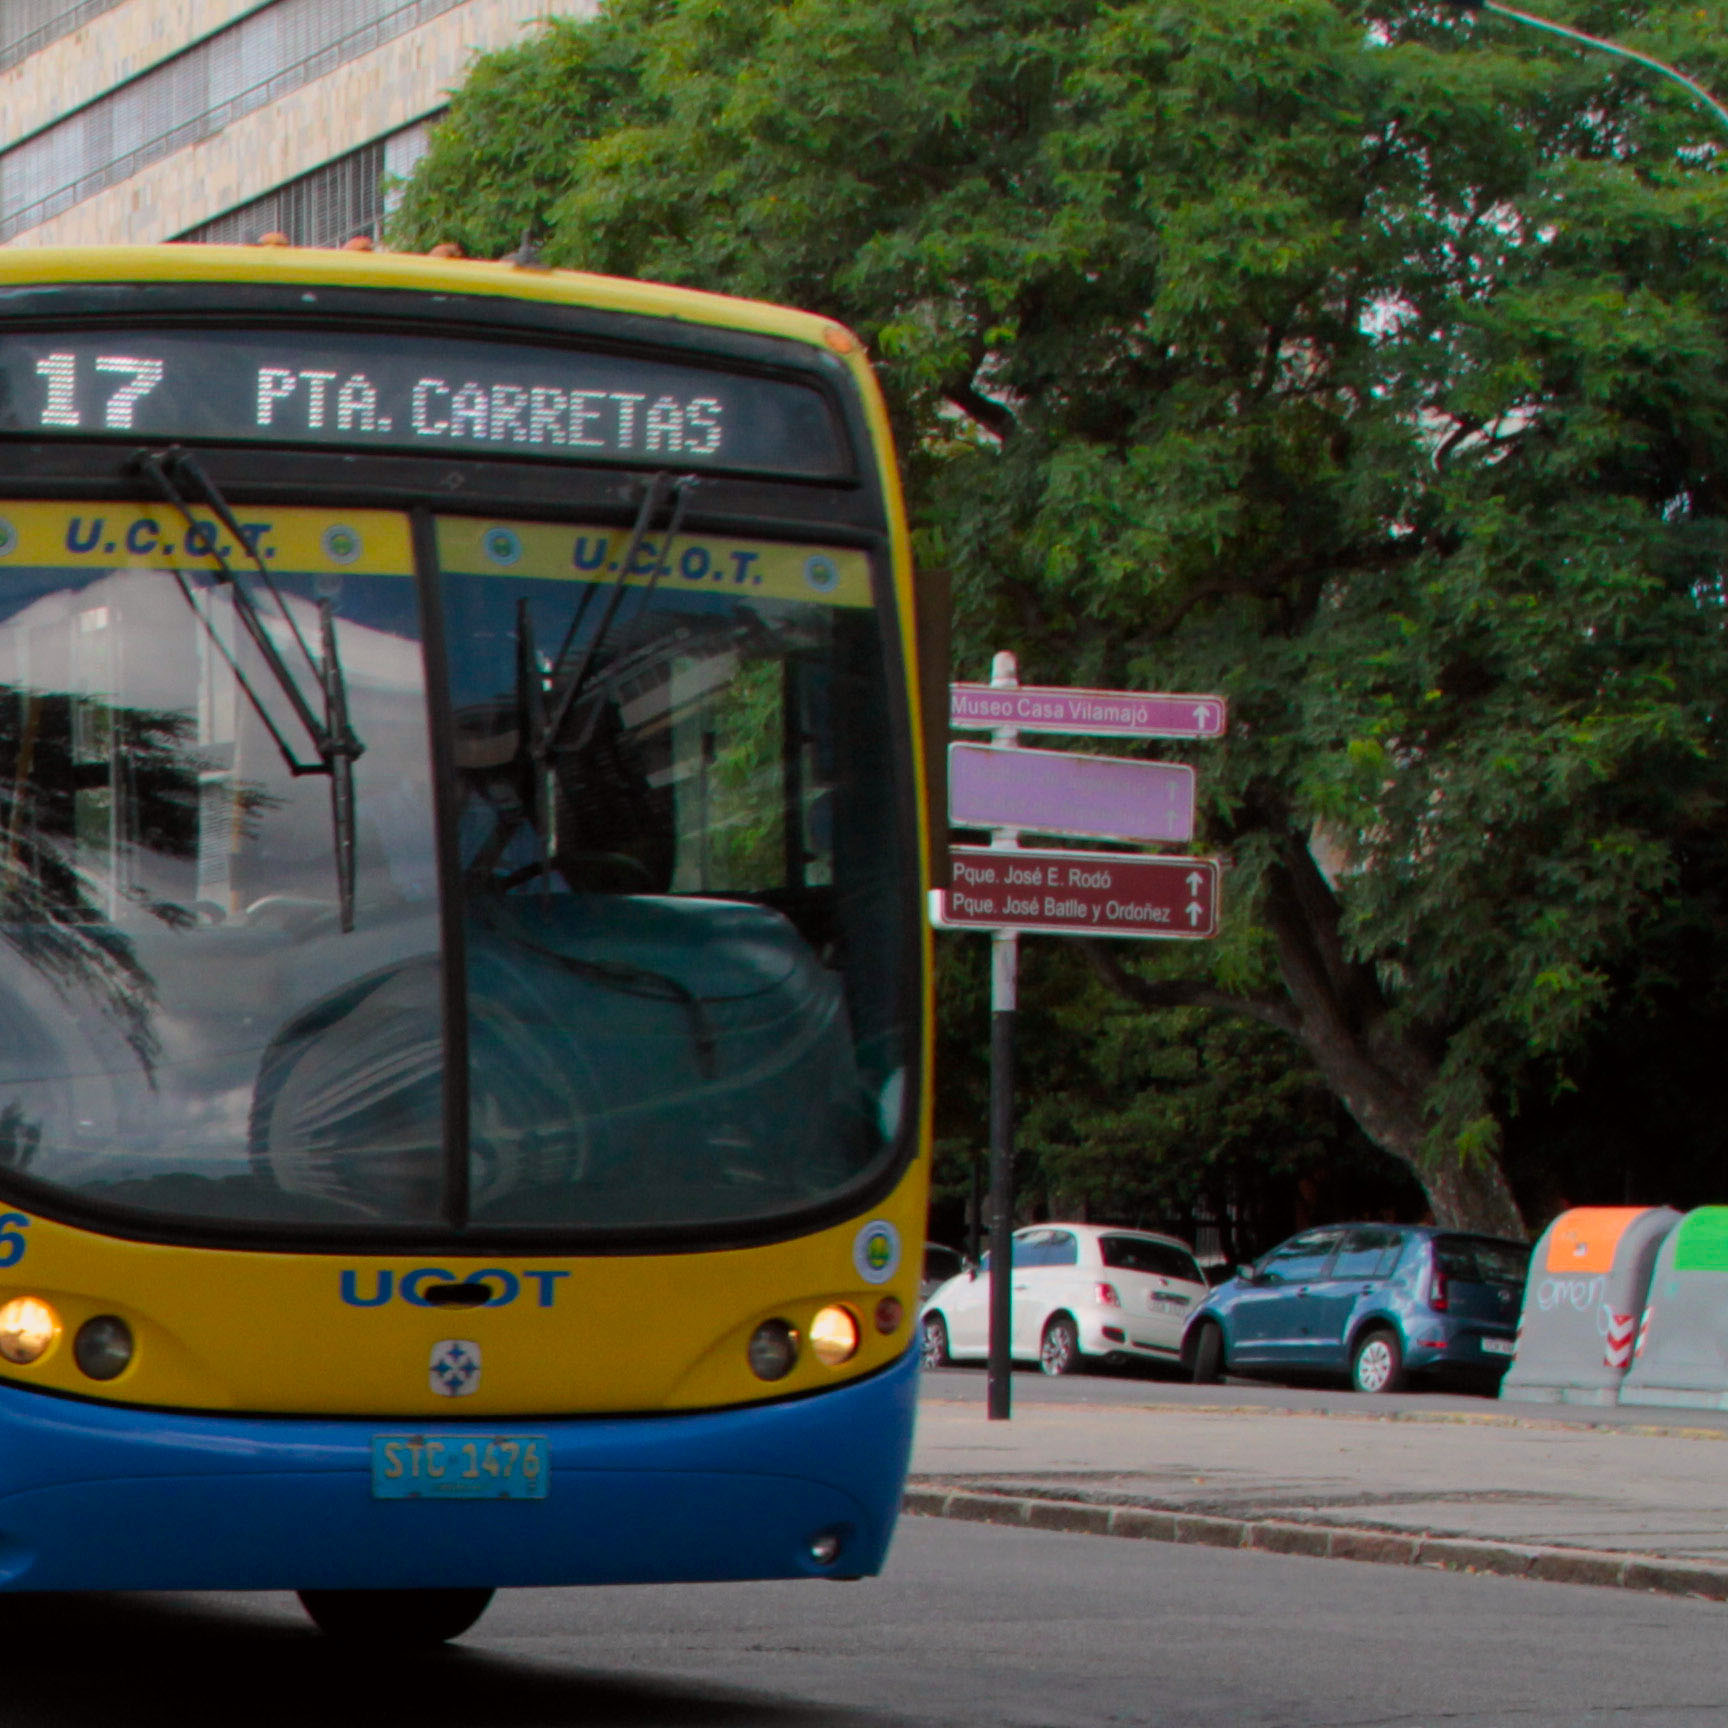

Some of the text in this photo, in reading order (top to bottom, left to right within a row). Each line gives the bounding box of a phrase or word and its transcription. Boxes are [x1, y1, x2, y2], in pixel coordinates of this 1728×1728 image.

[36, 353, 723, 454] 17 PTA. CARRETAS
[63, 516, 278, 560] U.C.O.T.
[570, 536, 765, 586] U.C.O.T.
[950, 696, 1149, 727] Museo Casa Vilamajó
[952, 862, 1112, 889] Pque. José E. Rodó
[952, 892, 1172, 923] Pque. José Batlle y Ordoñez
[337, 1268, 573, 1310] UCOT
[383, 1441, 542, 1479] STC 1476
